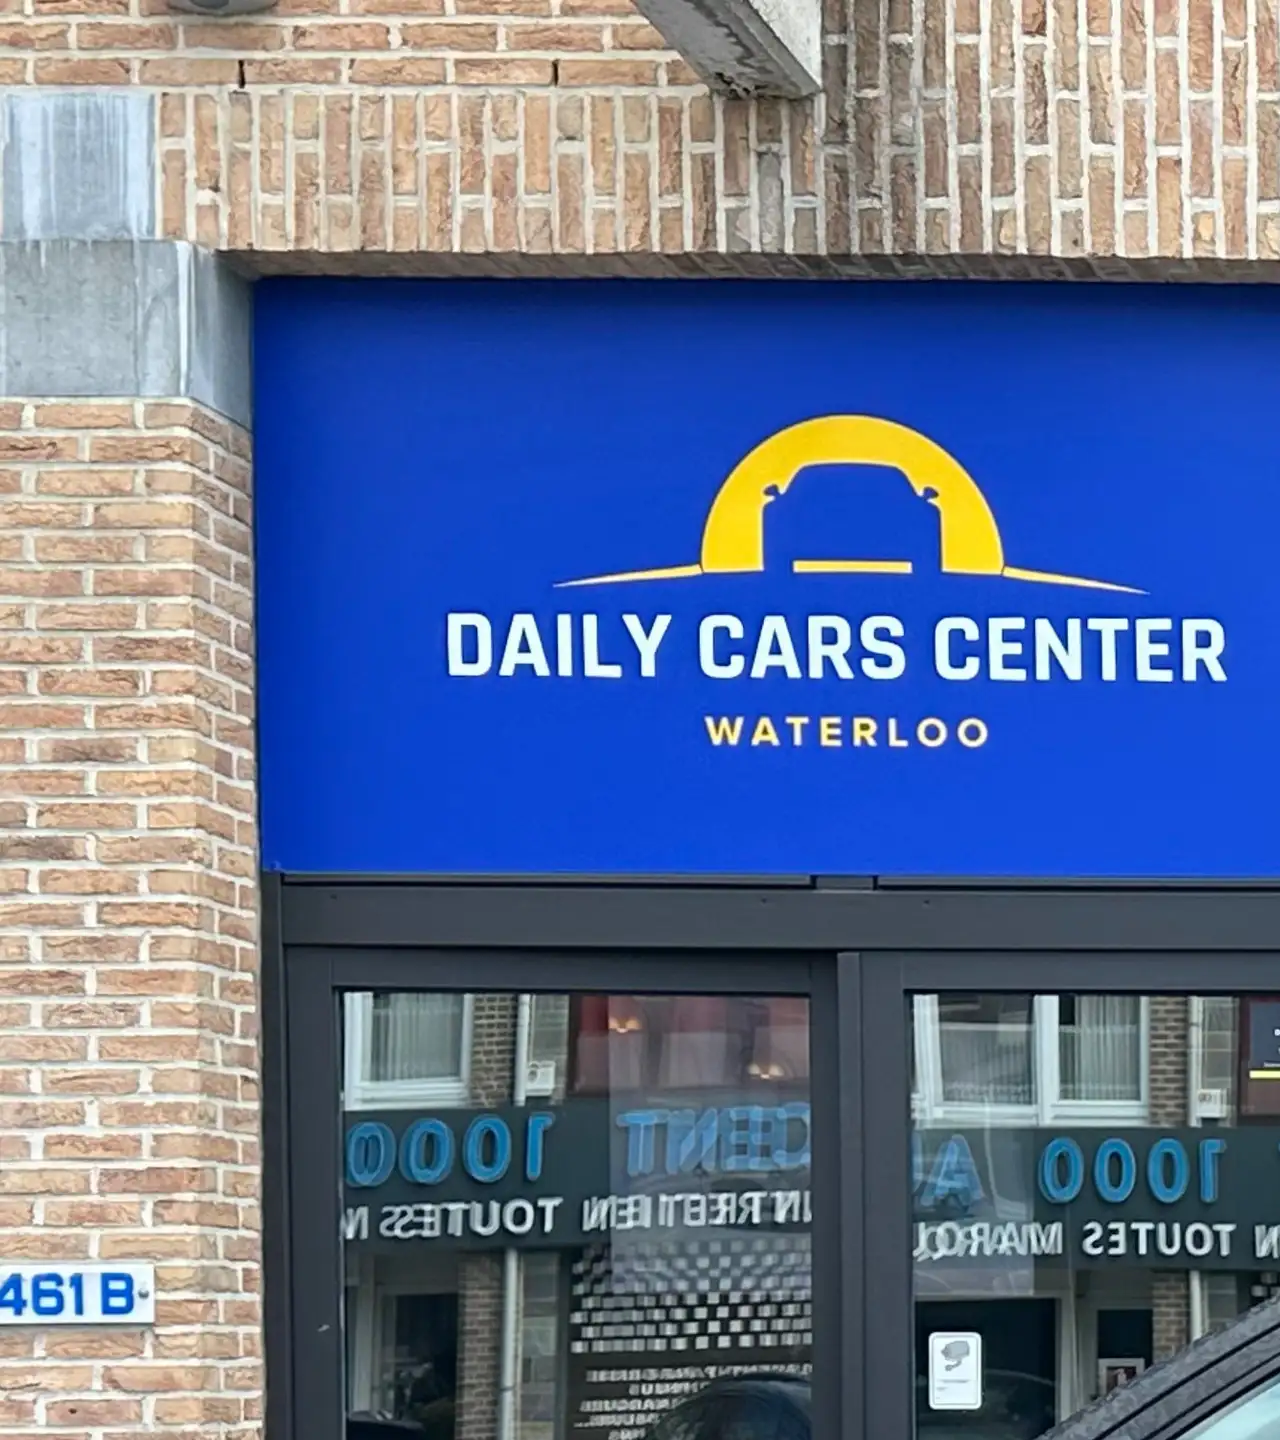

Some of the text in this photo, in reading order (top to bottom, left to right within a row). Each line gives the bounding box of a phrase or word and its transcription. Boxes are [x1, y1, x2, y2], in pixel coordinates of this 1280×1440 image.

[446, 613, 1227, 682] DAILY CARS CENTER
[705, 715, 989, 748] WATERLOO
[0, 1272, 135, 1316] 461 B
